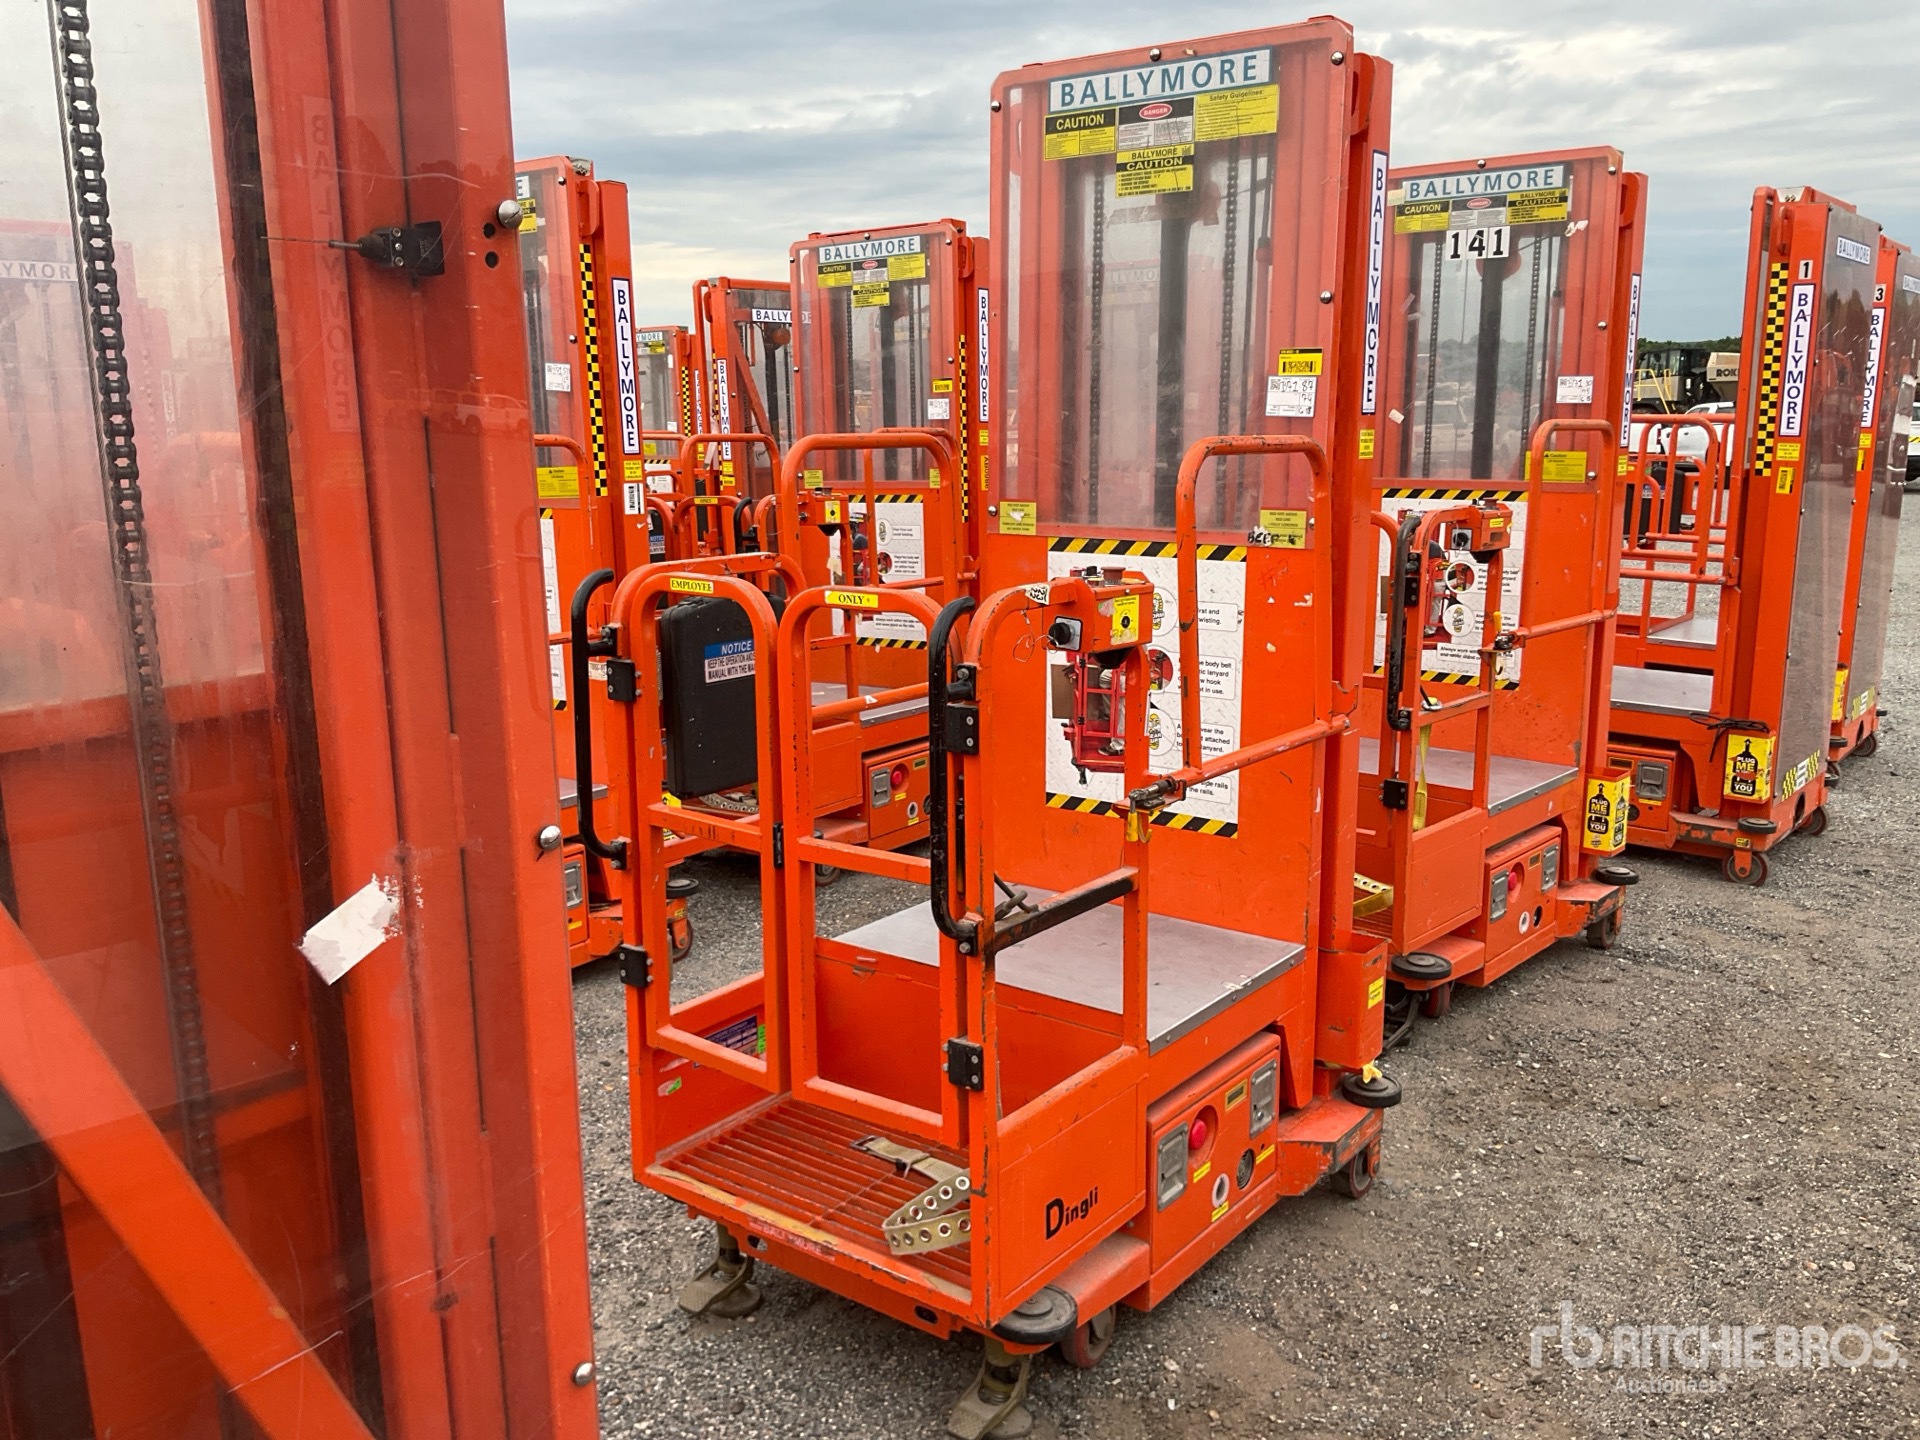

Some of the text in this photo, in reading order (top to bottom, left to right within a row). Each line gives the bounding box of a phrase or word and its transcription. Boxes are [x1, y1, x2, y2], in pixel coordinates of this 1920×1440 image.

[1061, 55, 1257, 107] BALLYMORE
[1143, 106, 1168, 116] DANGER
[1056, 113, 1104, 131] CAUTION
[1131, 147, 1178, 160] BALLYMORE
[1126, 157, 1183, 171] CAUTION
[1409, 168, 1555, 199] BALLYMORE
[1404, 203, 1441, 214] CAUTION
[1515, 197, 1560, 207] CAUTION
[825, 238, 915, 261] BALLYMORE
[1450, 228, 1504, 259] 141
[1803, 262, 1809, 278] 1
[1876, 288, 1884, 301] 3
[980, 297, 988, 417] BALLYMORE
[1623, 284, 1638, 440] BALLYMORE
[1786, 292, 1808, 430] BALLYMORE
[617, 289, 635, 447] BALLYMORE
[1861, 314, 1880, 423] BALLYMORE
[671, 580, 712, 591] EMPLOYEE
[838, 593, 865, 605] ONLY
[1199, 618, 1222, 626] wisting.
[721, 640, 752, 655] NOTICE
[707, 658, 717, 669] KEEP
[717, 657, 725, 668] THE
[725, 653, 745, 667] OPERATION
[1205, 661, 1219, 669] body
[708, 669, 727, 680] MANUAL
[727, 666, 738, 676] WITH
[739, 664, 748, 674] THE
[1205, 735, 1230, 745] attached
[1736, 756, 1756, 764] PLUG
[1736, 762, 1755, 771] ME
[1200, 787, 1214, 795] rails.
[1734, 783, 1753, 792] YOU
[1591, 798, 1608, 806] PLUG
[1591, 804, 1607, 812] ME
[1590, 823, 1606, 831] YOU
[1046, 1186, 1098, 1240] Dingli
